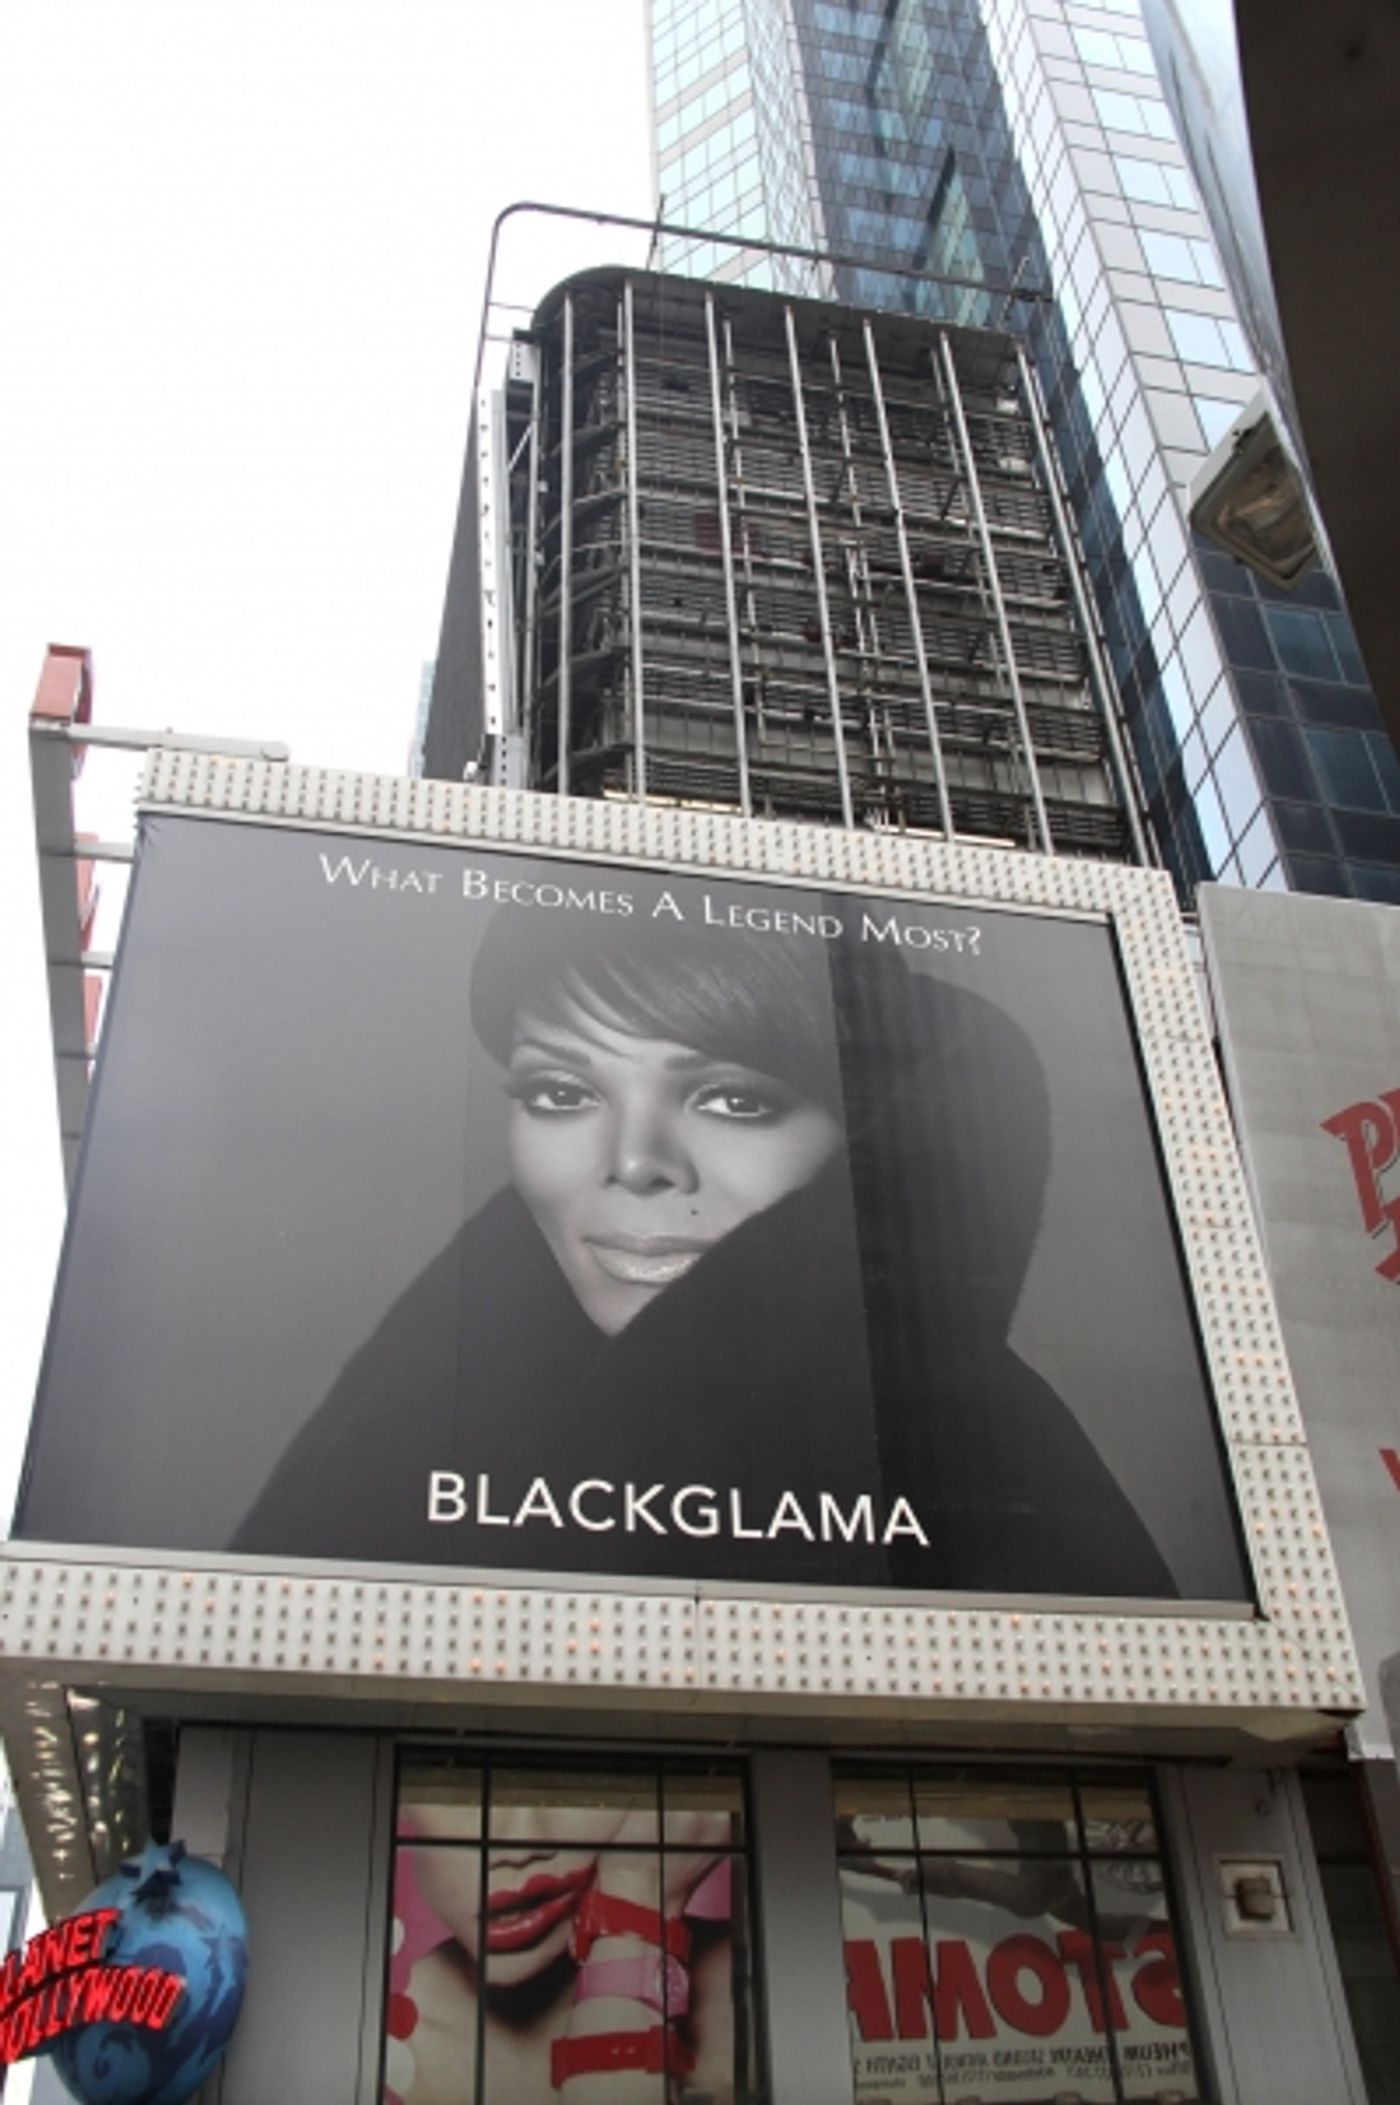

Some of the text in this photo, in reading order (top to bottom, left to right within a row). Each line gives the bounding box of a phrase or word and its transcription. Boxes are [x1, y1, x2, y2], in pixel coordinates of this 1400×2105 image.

[651, 890, 684, 922] A
[1319, 1087, 1400, 1233] P
[427, 1470, 930, 1547] BLACKGLAMA
[0, 1907, 121, 2010] LANET
